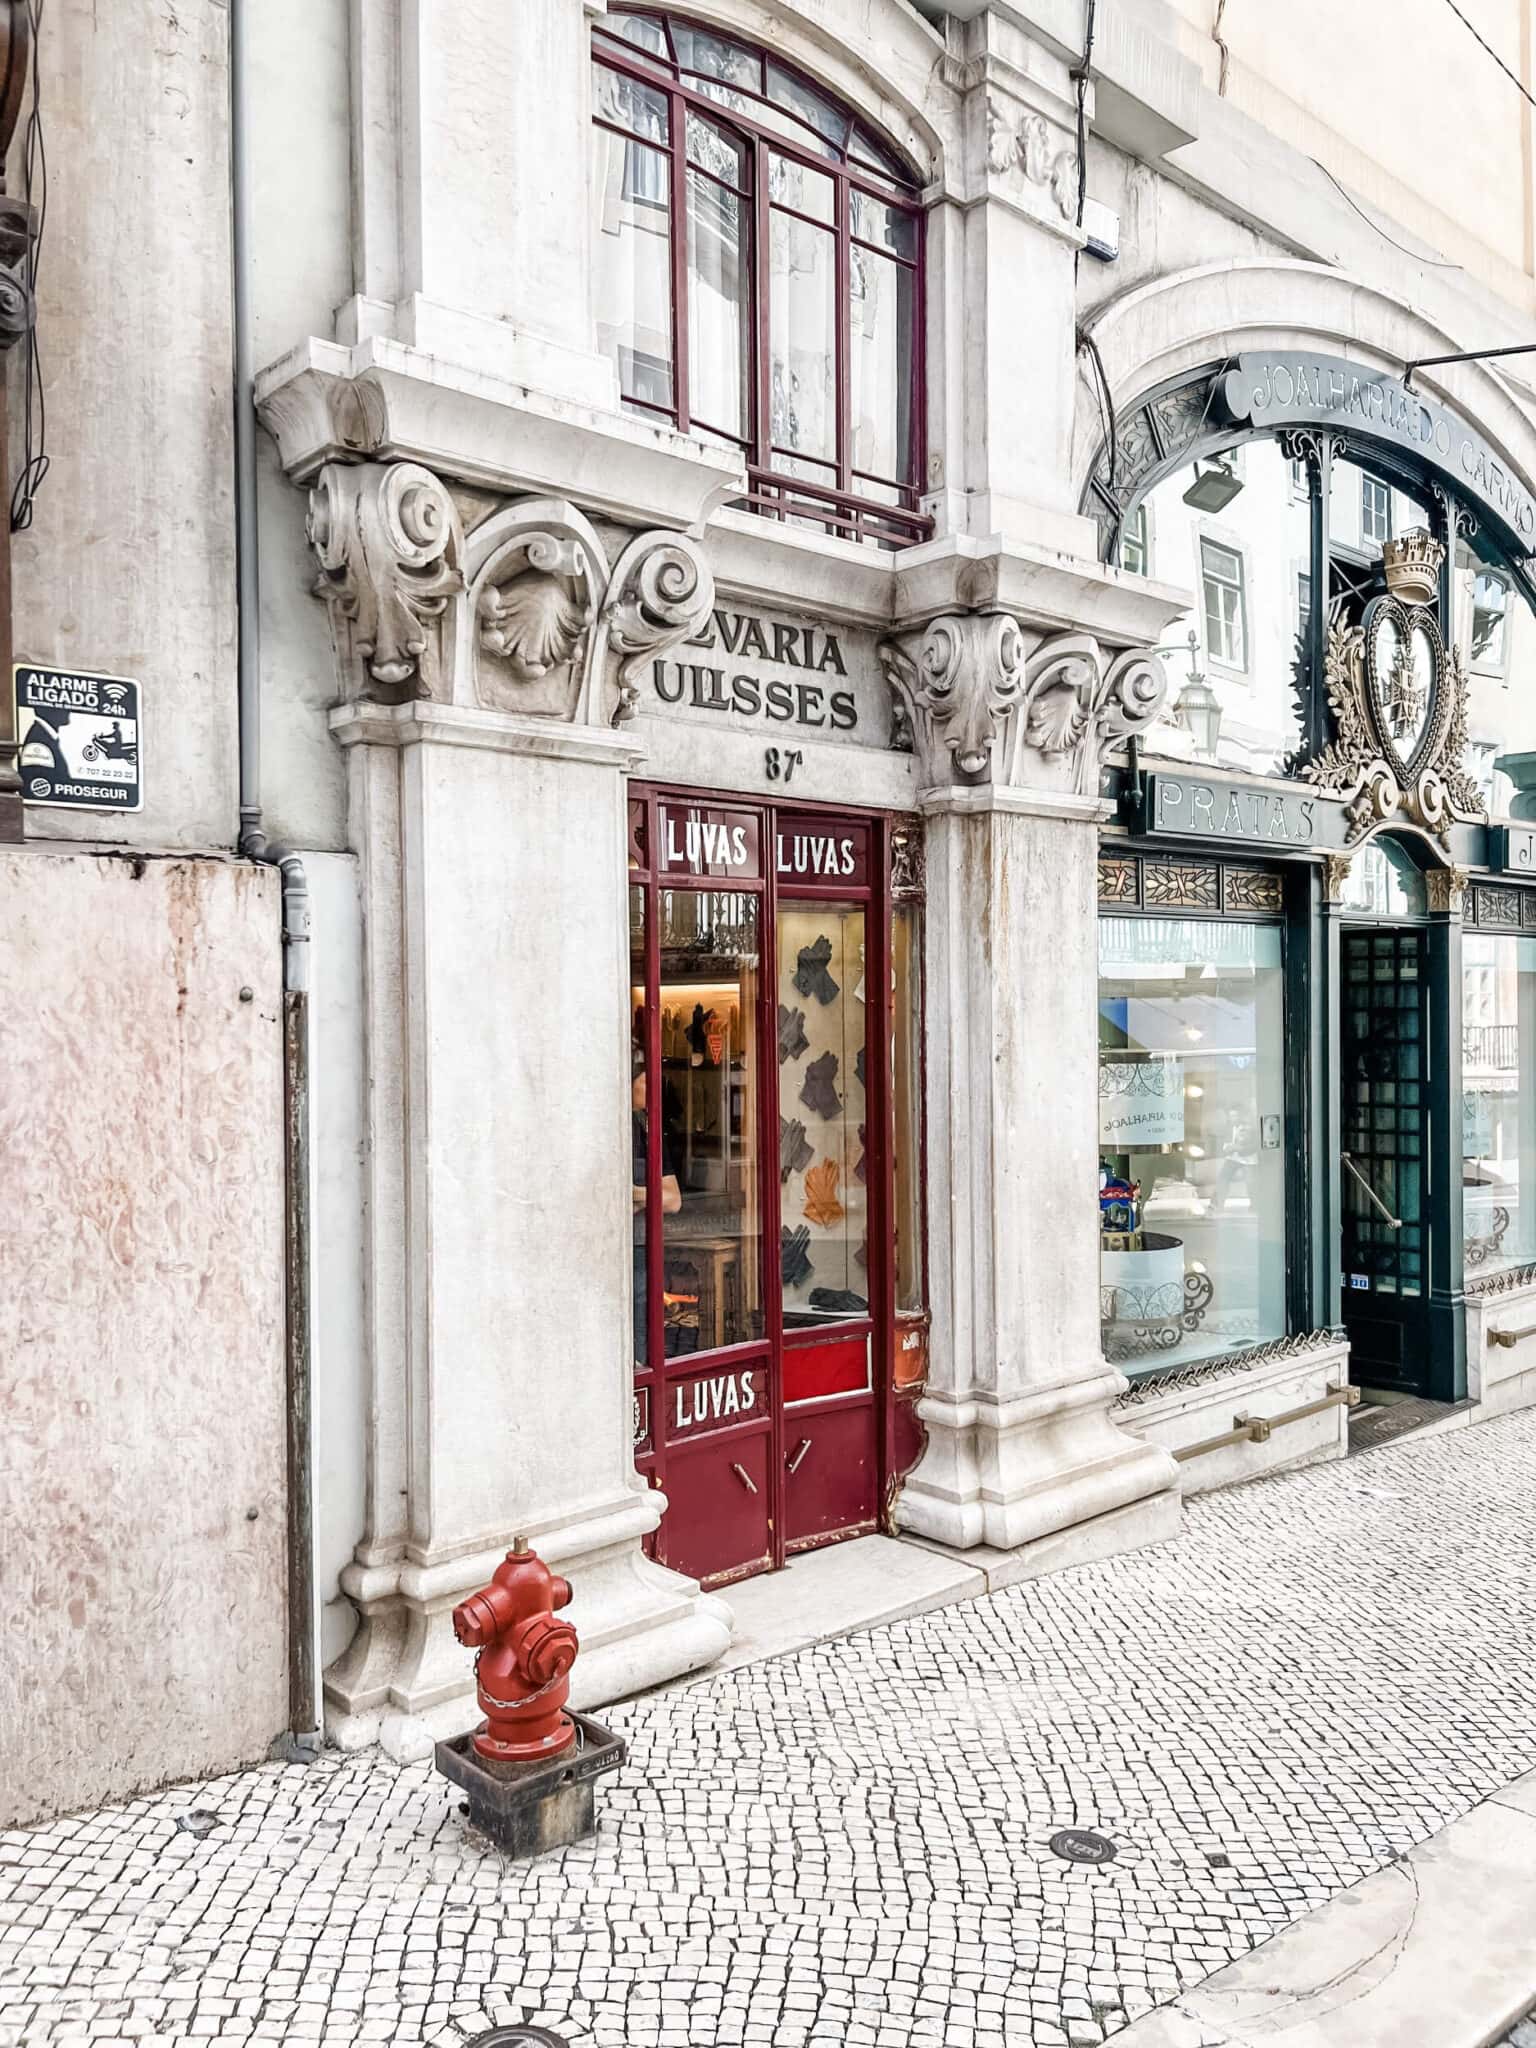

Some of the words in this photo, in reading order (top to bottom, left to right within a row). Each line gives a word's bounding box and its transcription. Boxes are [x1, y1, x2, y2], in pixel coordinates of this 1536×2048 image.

[1253, 365, 1413, 437] JOALHARIA
[1416, 404, 1451, 456] DO
[1461, 440, 1534, 534] CARMO
[27, 673, 98, 693] ALARME
[27, 686, 99, 707] LIGADO
[653, 660, 858, 730] ULISSES
[103, 703, 126, 716] 24h
[55, 784, 128, 800] PROSEGUR
[1156, 780, 1315, 841] PRATAS
[667, 819, 748, 866] LUVAS
[776, 834, 855, 876] LUVAS
[675, 1371, 755, 1428] LUVAS
